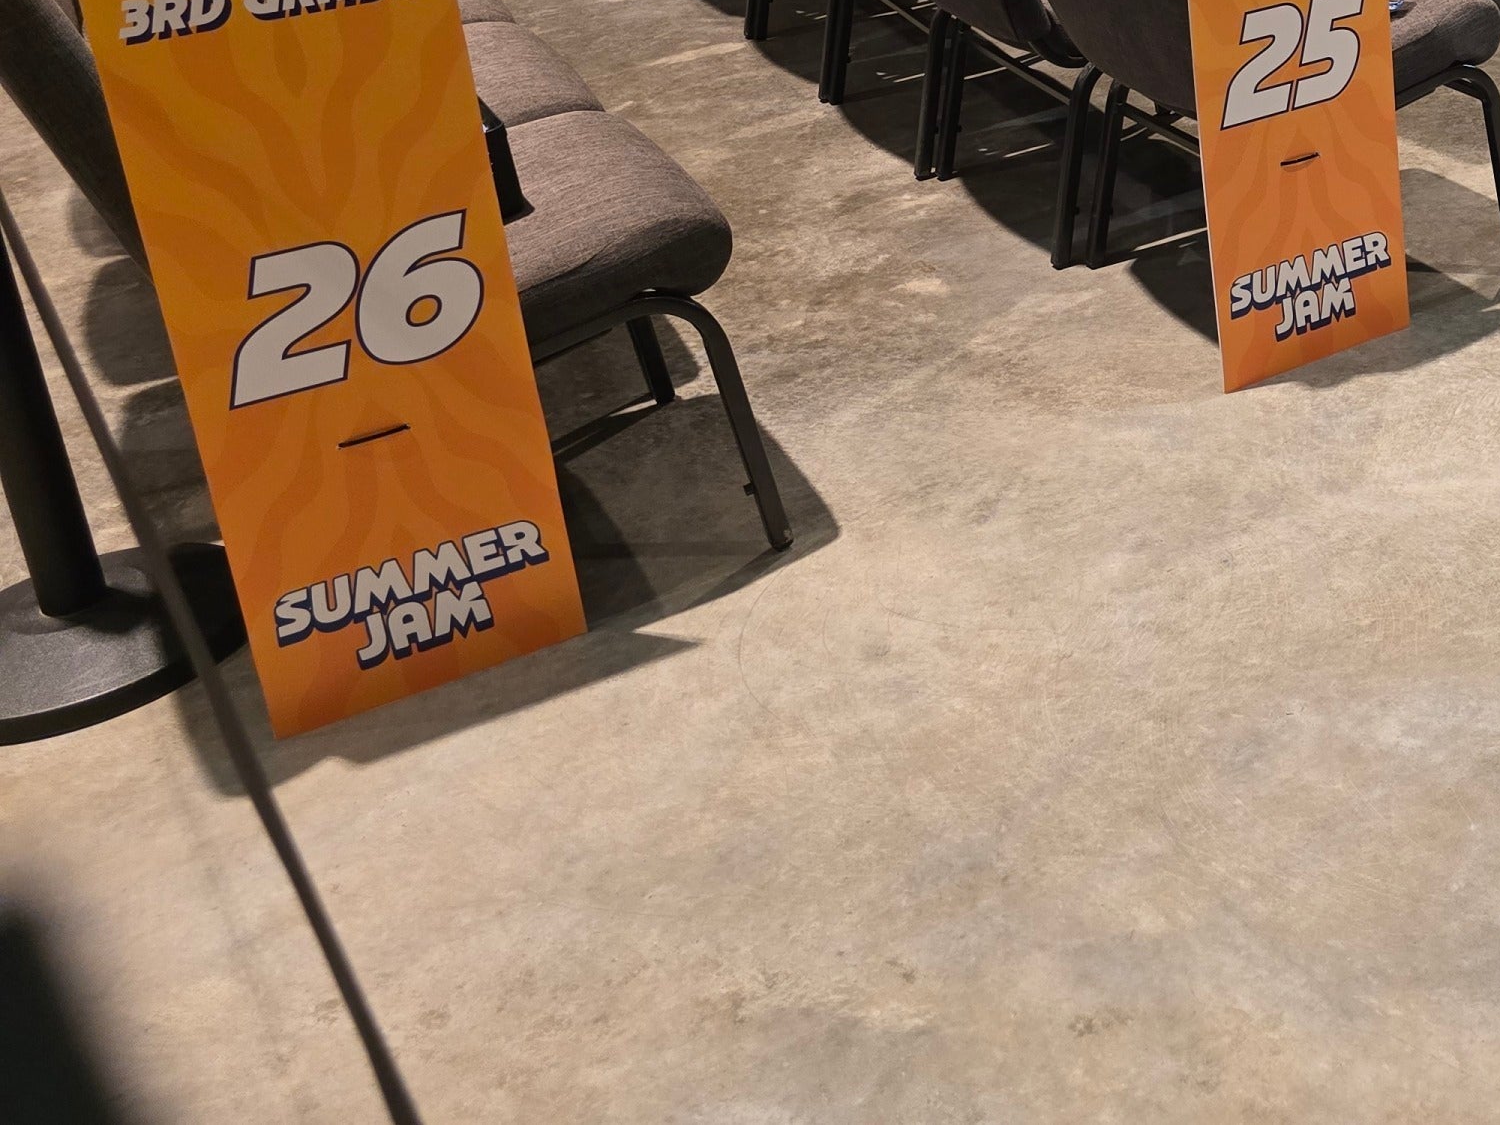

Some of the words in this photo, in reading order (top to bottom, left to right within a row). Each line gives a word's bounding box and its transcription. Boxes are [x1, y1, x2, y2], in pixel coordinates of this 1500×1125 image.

[229, 209, 485, 410] 26
[1230, 230, 1391, 320] SUMMER
[1274, 278, 1357, 342] JAM
[275, 519, 551, 647] SUMMER
[357, 587, 493, 670] JAM
